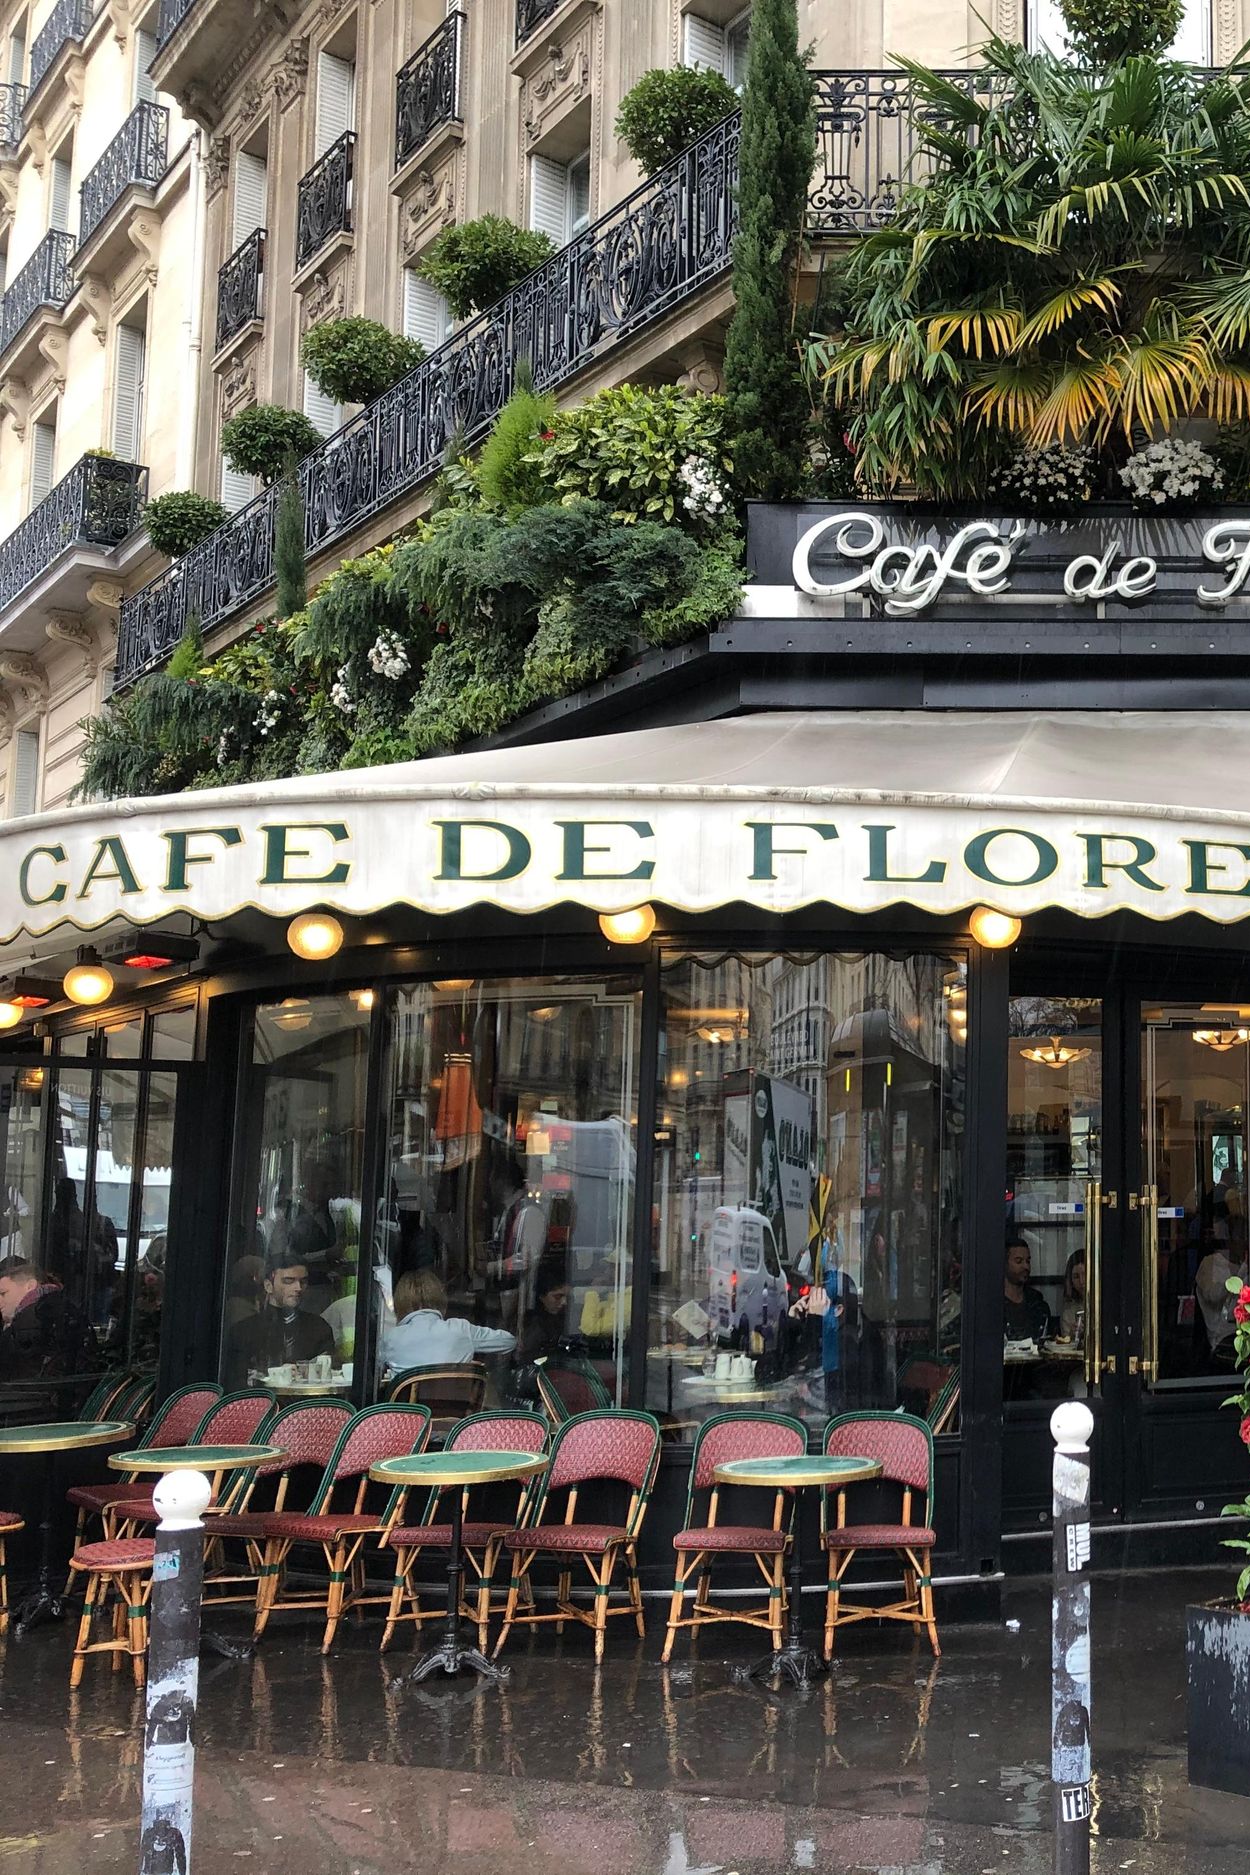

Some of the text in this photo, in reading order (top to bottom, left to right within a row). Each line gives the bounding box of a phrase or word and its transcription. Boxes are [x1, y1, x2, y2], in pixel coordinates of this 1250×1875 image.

[792, 512, 1026, 615] Café
[1063, 541, 1157, 599] de
[19, 819, 353, 908] CAFE
[429, 818, 657, 882] DE
